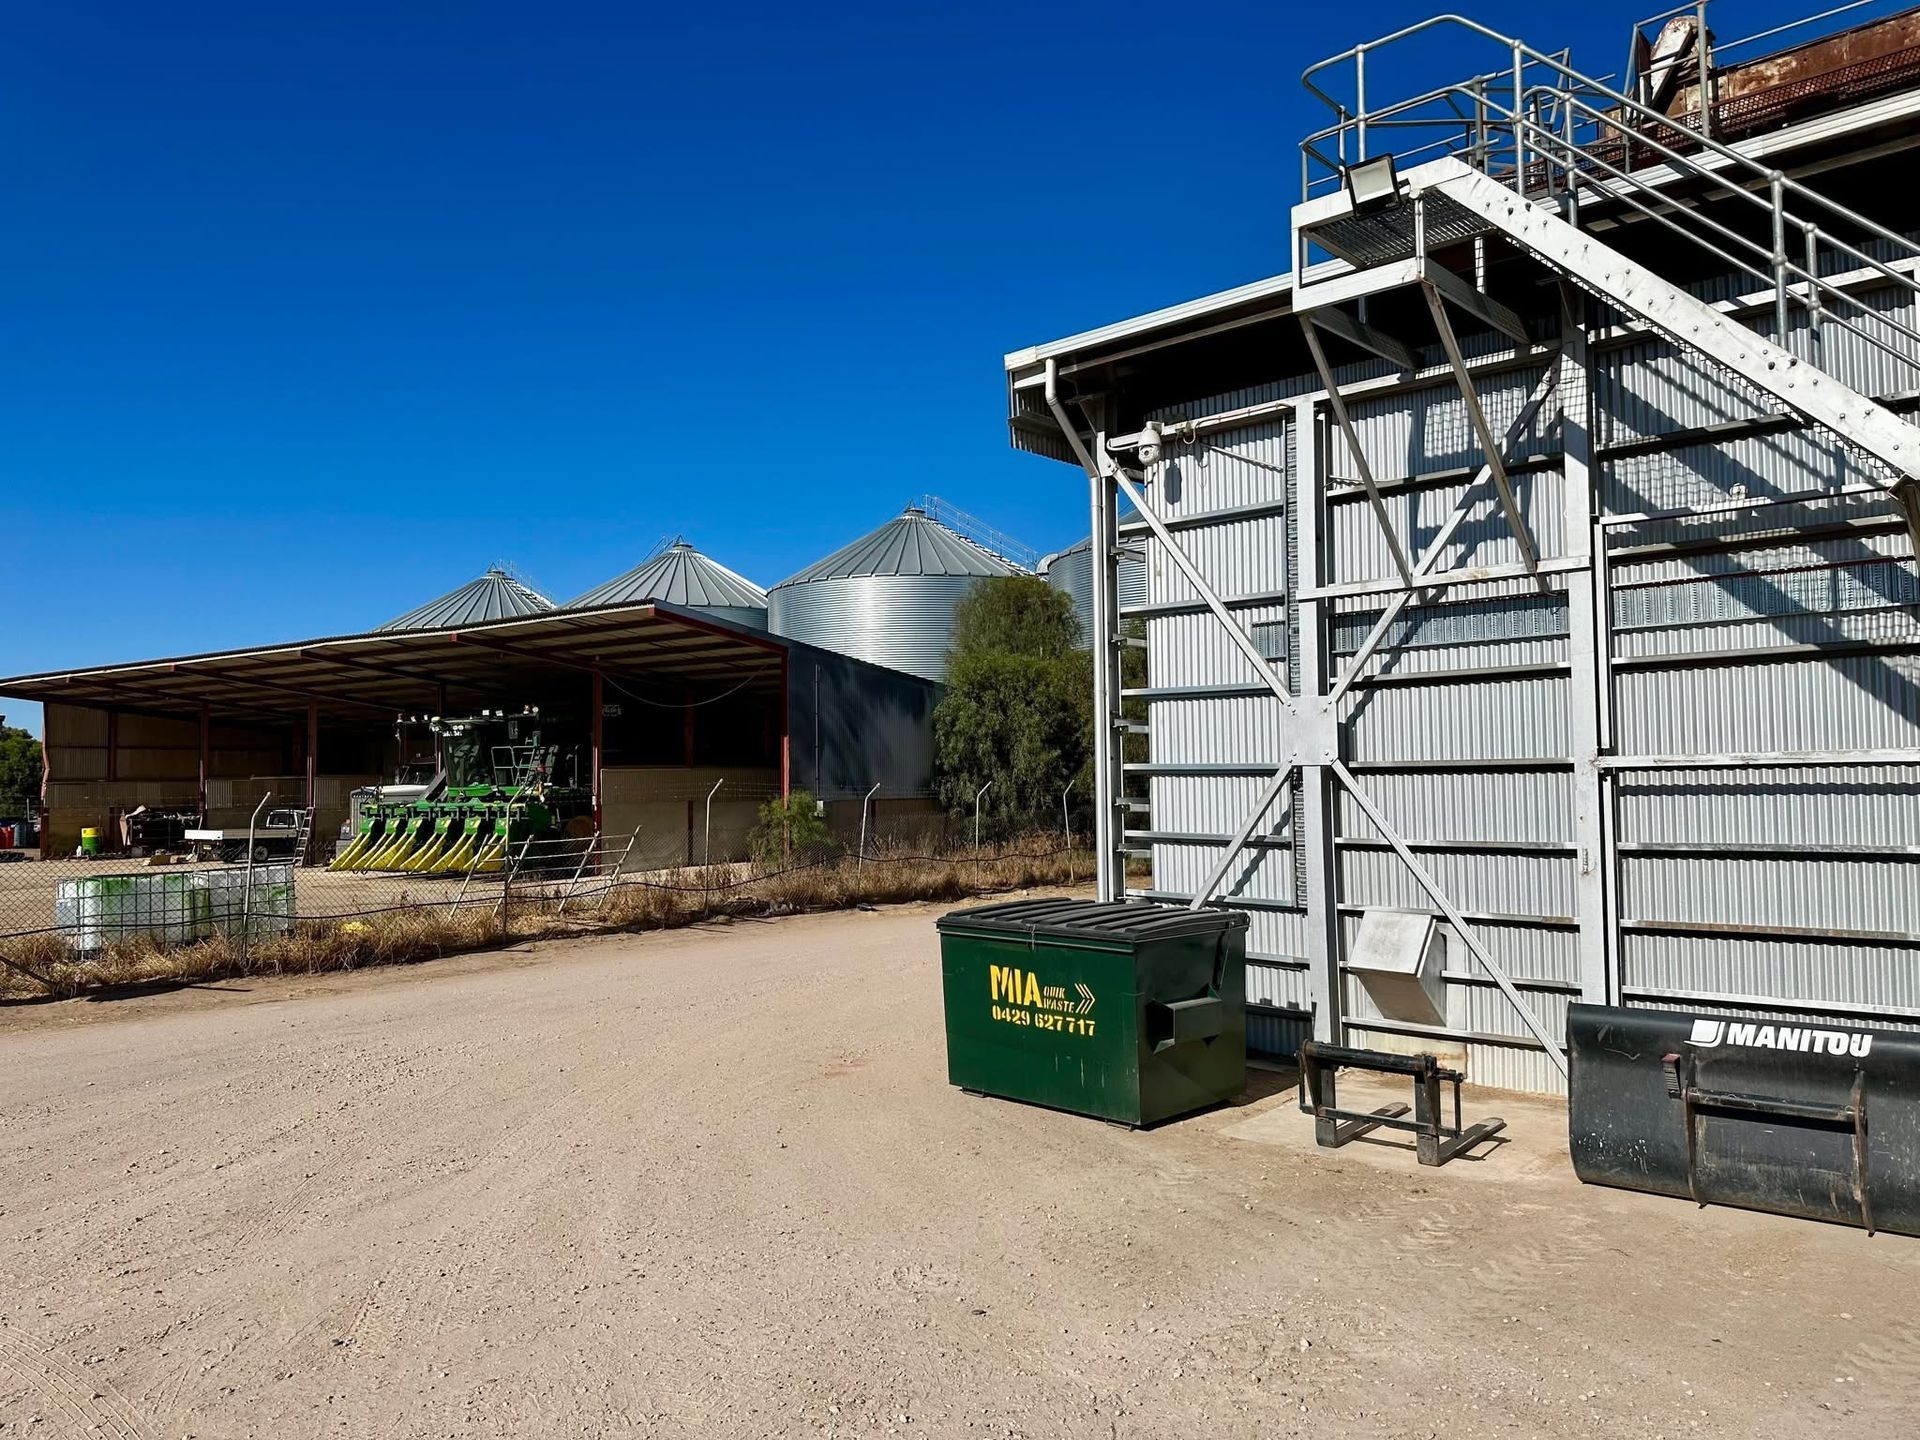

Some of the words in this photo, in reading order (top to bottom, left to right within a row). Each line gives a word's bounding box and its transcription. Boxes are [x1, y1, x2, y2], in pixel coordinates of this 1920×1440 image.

[990, 964, 1043, 1008] MIA
[992, 1004, 1031, 1026] 0429
[1043, 998, 1075, 1014] WASTE
[1726, 1022, 1873, 1058] MANITOU
